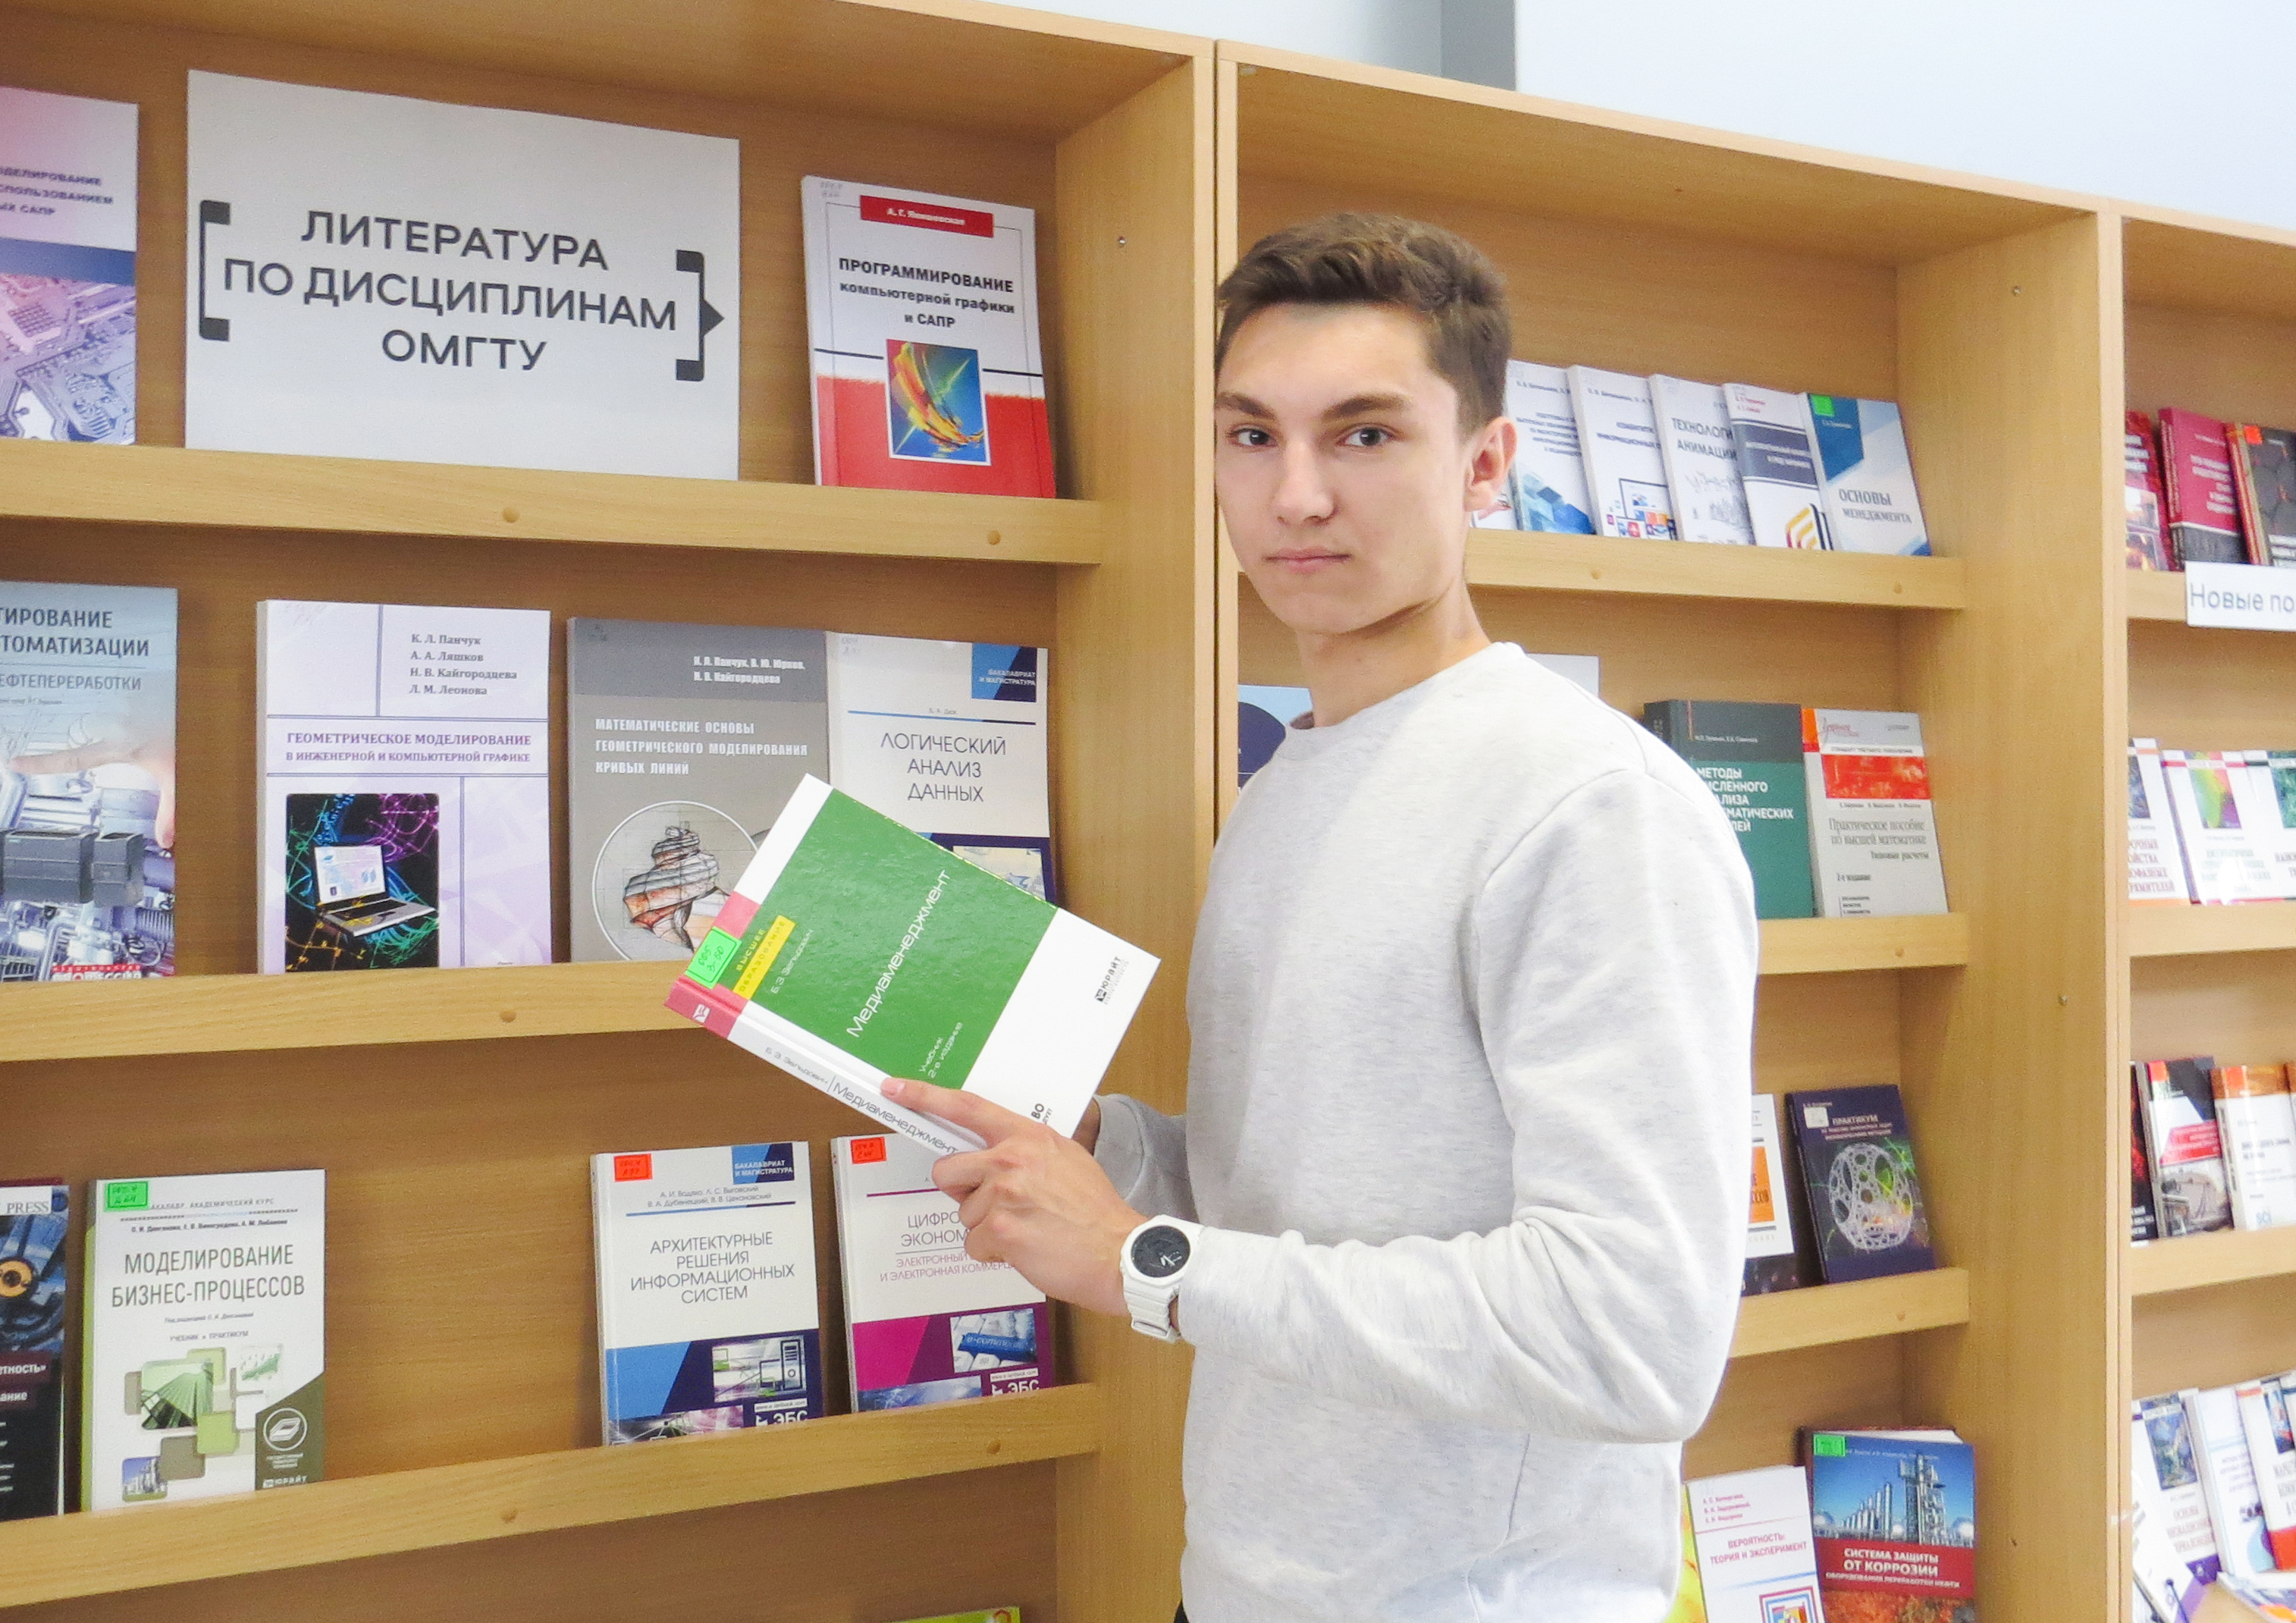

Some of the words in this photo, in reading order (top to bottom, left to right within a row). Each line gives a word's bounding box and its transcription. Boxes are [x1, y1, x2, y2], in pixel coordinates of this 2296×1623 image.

[301, 210, 609, 271] ЛИТЕРАТУРА
[839, 258, 1014, 293] ПРОГРАММИРОВАНИЕ
[224, 259, 294, 297] ПО
[303, 267, 676, 331] ДИСЦИПЛИНАМ
[840, 282, 951, 305] компьютерной
[955, 297, 1015, 314] графики
[905, 315, 913, 324] и
[917, 313, 955, 328] САПР
[382, 329, 547, 371] ОМГТУ
[1838, 488, 1892, 506] ОСНОВЫ
[2190, 582, 2263, 611] Новые
[0, 635, 149, 658] ТОМАТИЗАЦИИ
[438, 635, 481, 646] Панчук
[438, 651, 483, 662] Ляшков
[438, 668, 517, 680] Кайгородцева
[438, 686, 488, 695] Леонова
[595, 719, 700, 733] МАТЕМАТИЧЕСКИЕ
[705, 721, 754, 734] ОСНОВЫ
[287, 733, 412, 745] ГЕОМЕТРИЧЕСКОЕ
[415, 734, 532, 746] МОДЕЛИРОВАНИЕ
[595, 740, 704, 754] ГЕОМЕТРИЧЕСКОГО
[709, 742, 808, 757] МОДЕЛИРОВАНИЯ
[881, 733, 1006, 755] ЛОГИЧЕСКИЙ
[296, 751, 375, 761] ИНЖЕНЕРНОЙ
[388, 752, 481, 762] КОМПЬЮТЕРНОЙ
[482, 752, 530, 763] ГРАФИКЕ
[595, 761, 645, 774] КРИВЫХ
[650, 761, 689, 775] ЛИНИЙ
[908, 758, 981, 778] АНАЛИЗ
[1696, 768, 1742, 780] МЕТОДЫ
[908, 783, 983, 802] ДАННЫХ
[738, 918, 786, 994] ОБРАЗОВАНИЕ
[846, 870, 951, 1038] Медиаменеджмент
[831, 1081, 959, 1160] Медиаменеджмент
[7, 1201, 49, 1213] PRESS
[650, 1232, 773, 1254] АРХИТЕКТУРНЫЕ
[124, 1244, 294, 1276] МОДЕЛИРОВАНИЕ
[676, 1251, 749, 1270] РЕШЕНИЯ
[896, 1251, 968, 1267] ЭЛЕКТРОННЫЙ
[631, 1264, 795, 1291] ИНФОРМАЦИОННЫХ
[880, 1273, 888, 1282] И
[890, 1267, 960, 1281] ЭЛЕКТРОННАЯ
[112, 1276, 305, 1307] БИЗНЕС-ПРОЦЕССОВ
[681, 1286, 748, 1304] СИСТЕМ
[1710, 1552, 1740, 1565] ТЕОРИЯ
[1750, 1541, 1807, 1558] ЭКСПЕРИМЕНТ
[1844, 1548, 1892, 1560] СИСТЕМА
[1893, 1551, 1939, 1564] ЗАЩИТЫ
[1843, 1559, 1862, 1571] ОТ
[1865, 1561, 1939, 1577] КОРРОЗИИ
